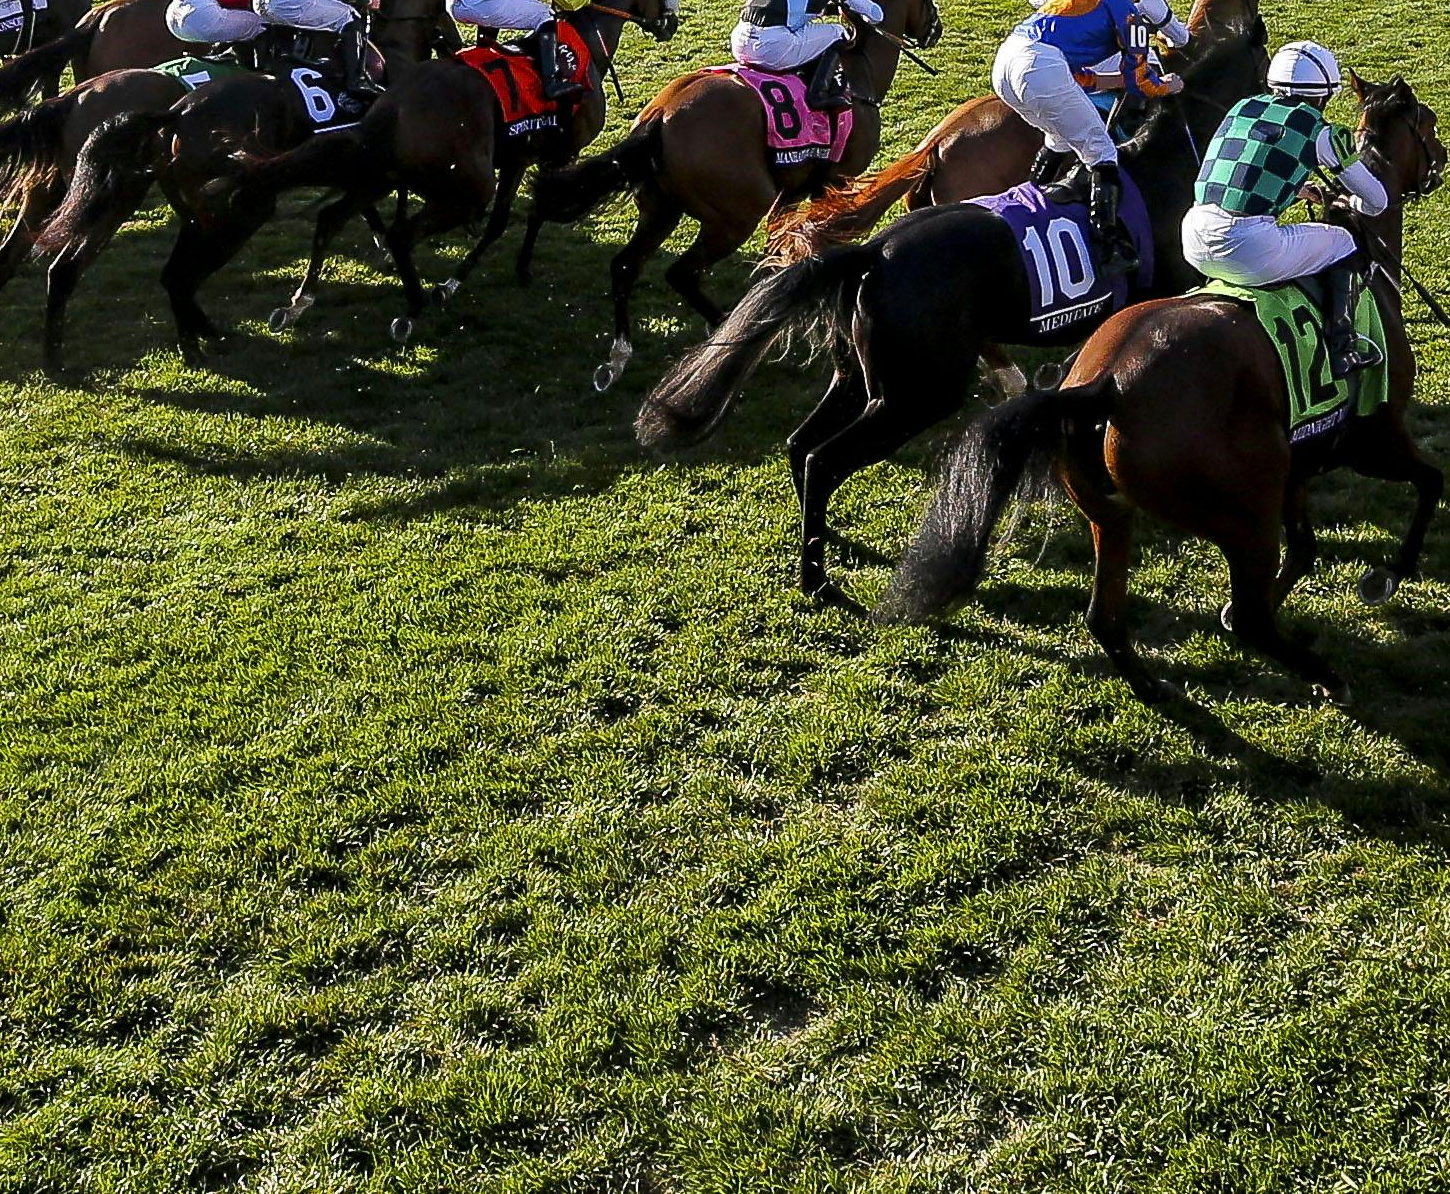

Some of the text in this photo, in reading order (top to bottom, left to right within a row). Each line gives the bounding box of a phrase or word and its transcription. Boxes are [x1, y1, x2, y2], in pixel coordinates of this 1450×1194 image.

[1130, 24, 1147, 48] 10
[290, 67, 336, 123] 6
[483, 58, 518, 113] 7
[760, 80, 803, 139] 8
[1023, 217, 1096, 307] 10
[1038, 304, 1103, 333] MEDITATE
[1273, 305, 1340, 416] 12
